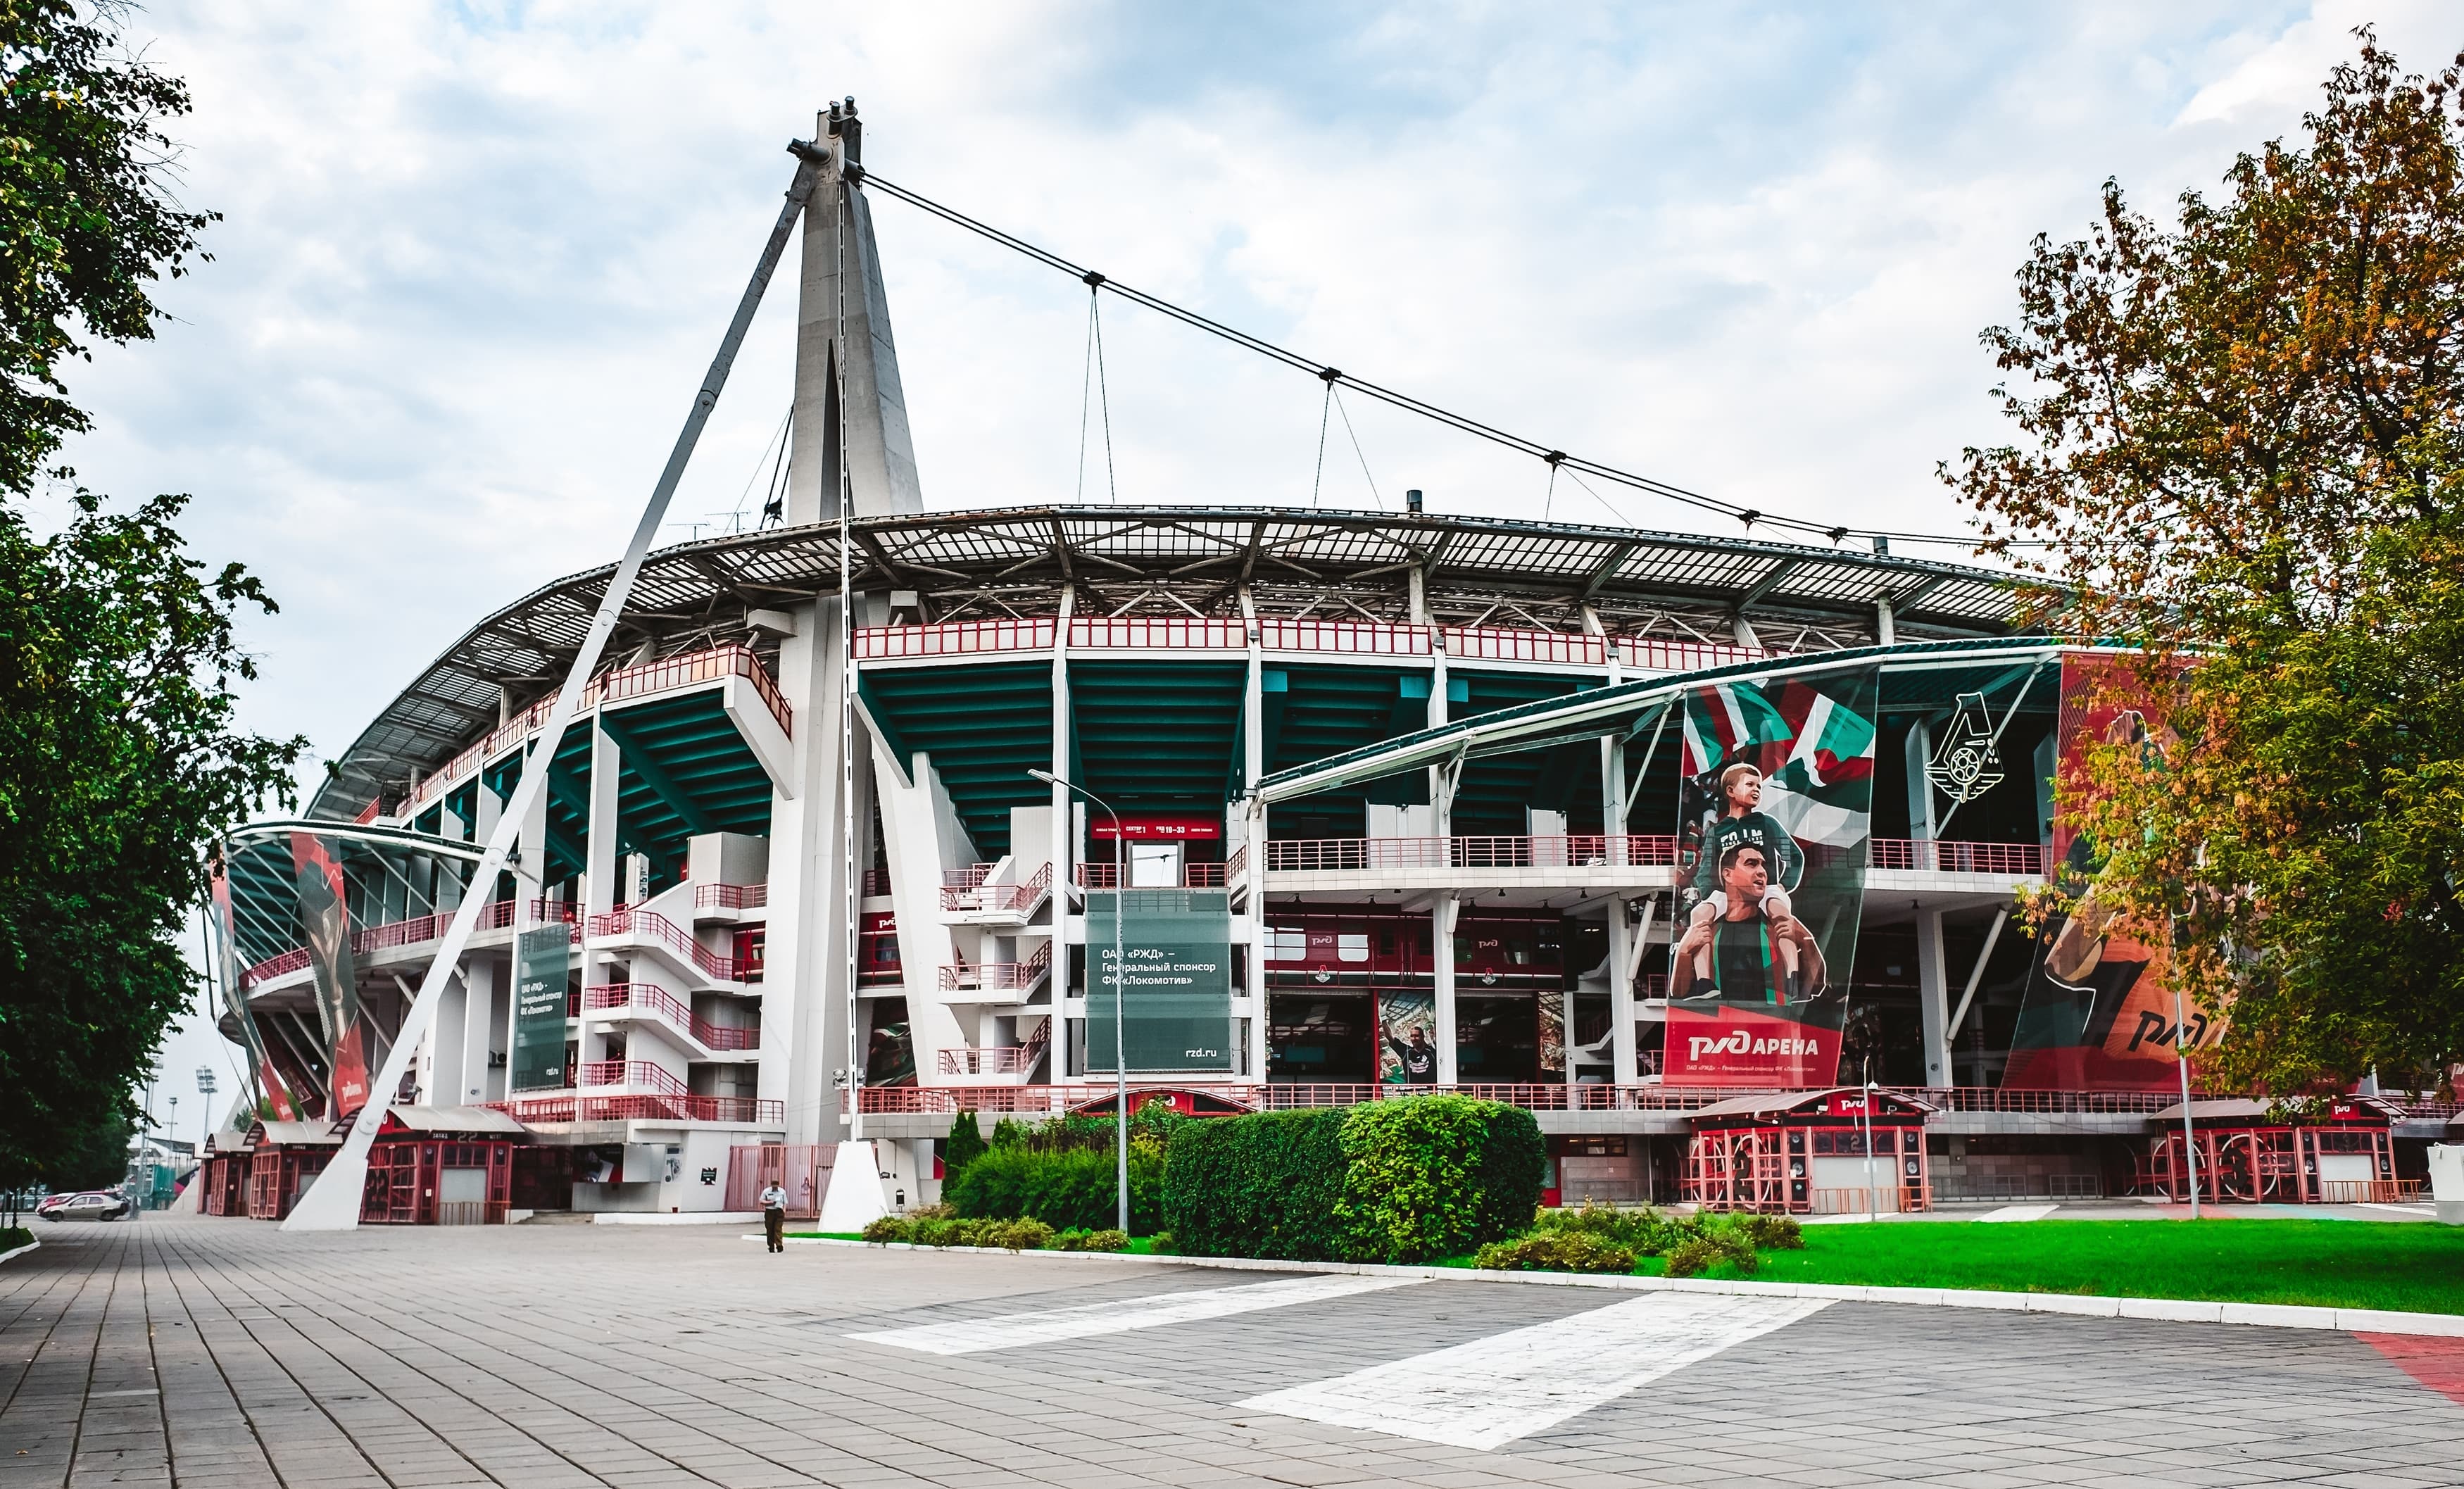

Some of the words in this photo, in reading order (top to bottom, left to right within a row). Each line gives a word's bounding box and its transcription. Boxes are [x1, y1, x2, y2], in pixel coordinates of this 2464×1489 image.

[1102, 949, 1124, 959] ОА
[1174, 963, 1217, 973] спонсор
[1102, 975, 1119, 986] ФК
[1688, 1030, 1751, 1061] РЖД
[1752, 1038, 1818, 1055] АРЕНА
[1186, 1047, 1217, 1058] rzd.ru
[457, 1131, 478, 1144] 22
[1850, 1135, 1860, 1151] 2
[1733, 1150, 1752, 1195] 2
[2221, 1147, 2247, 1188] 3
